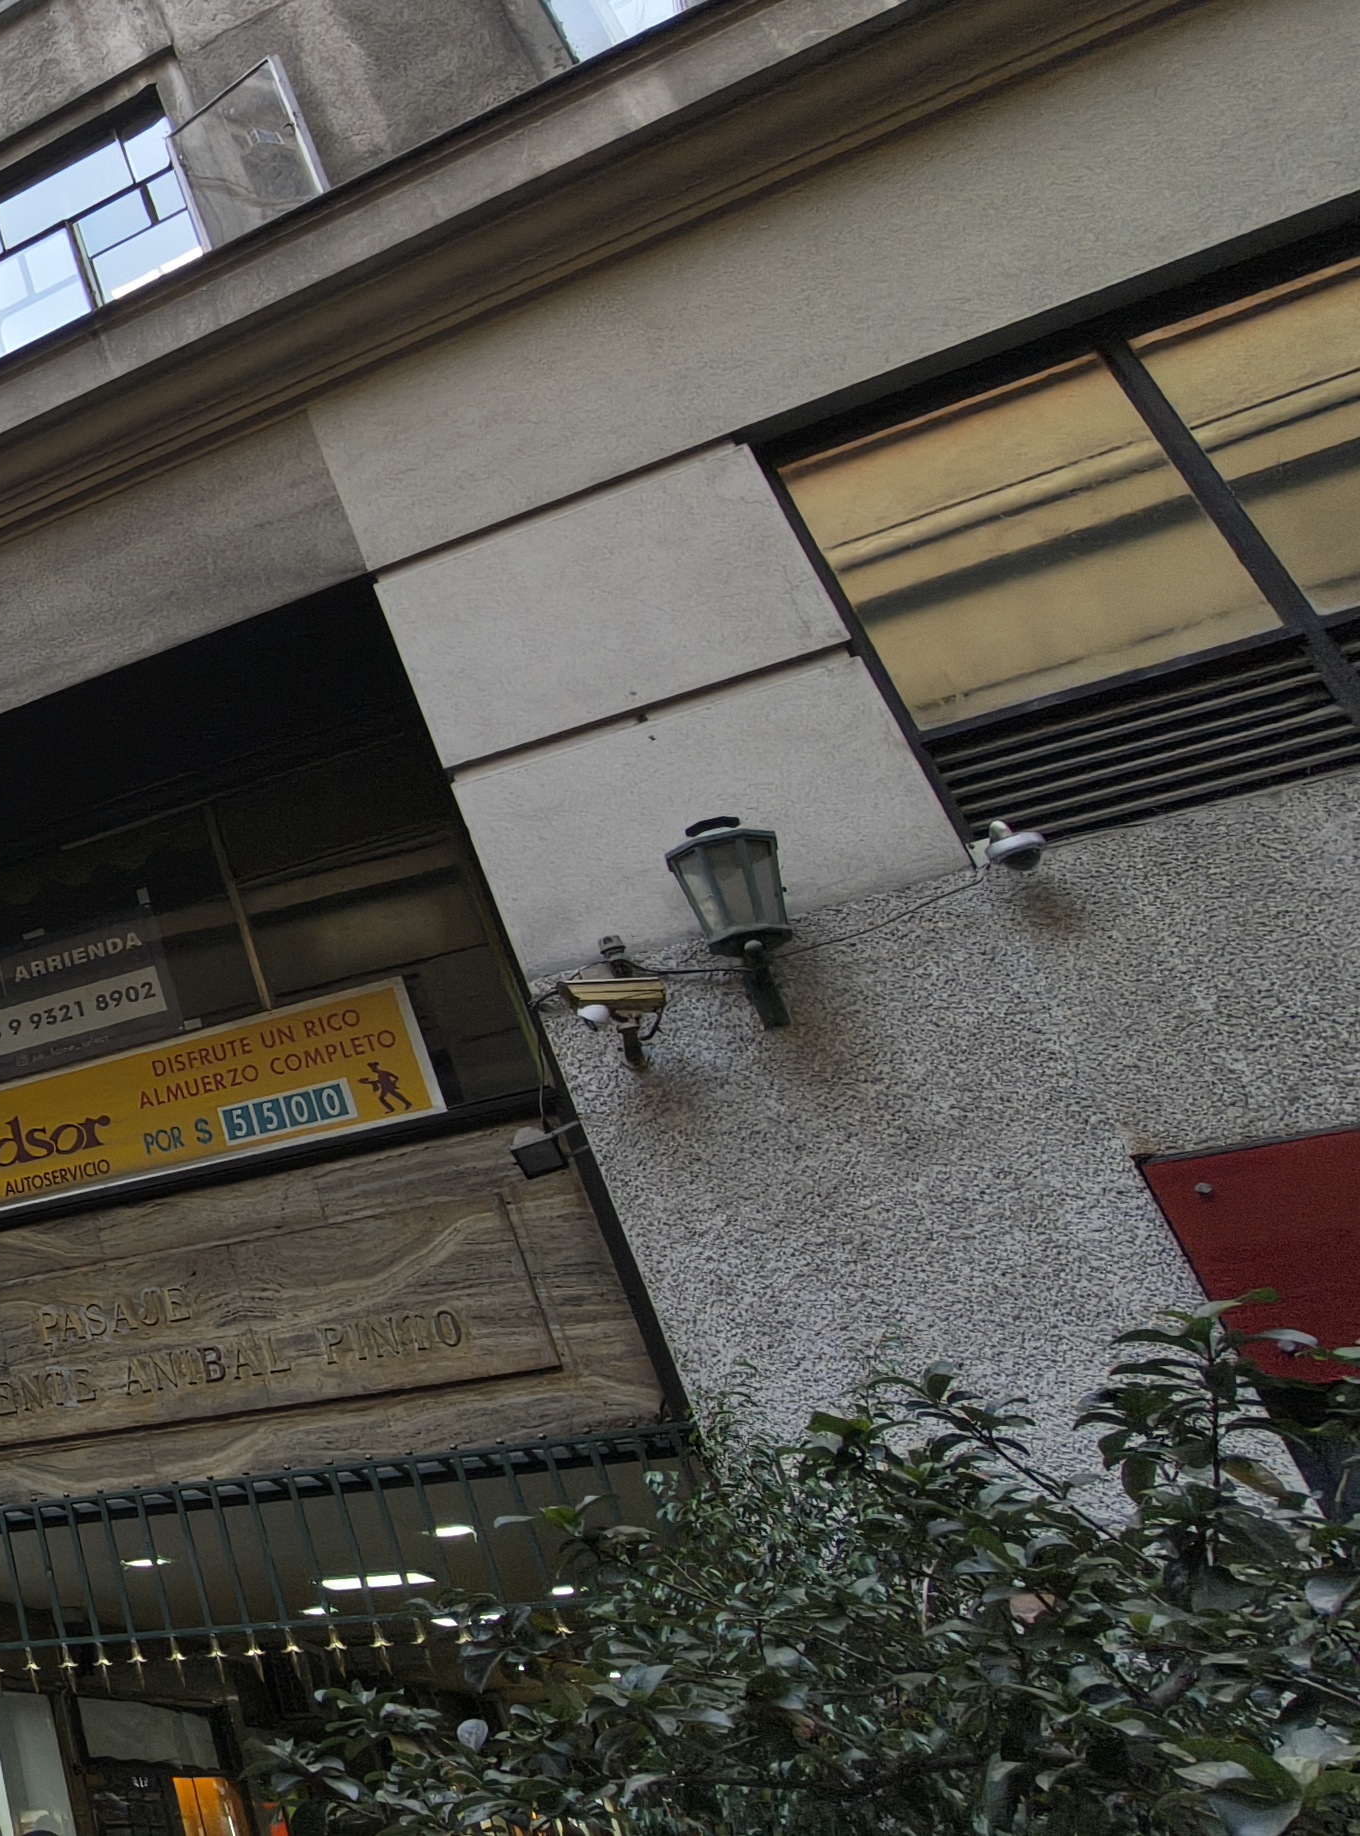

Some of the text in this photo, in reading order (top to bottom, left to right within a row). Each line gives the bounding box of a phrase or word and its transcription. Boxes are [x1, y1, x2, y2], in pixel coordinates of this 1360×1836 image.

[14, 932, 143, 983] ARRIENDA
[8, 1018, 22, 1036] 9
[30, 1001, 85, 1031] 9321
[95, 981, 157, 1012] 8902
[139, 1029, 396, 1110] ALMUERZO COMPLETO
[151, 1009, 361, 1077] DISFRUTE UN RICO
[143, 1125, 185, 1156] POR
[232, 1087, 341, 1137] 5500
[5, 1159, 111, 1198] AUTOSERVICIO
[36, 1285, 194, 1346] PASAJE
[122, 1343, 292, 1397] ANIBAL
[320, 1307, 464, 1367] PINTO
